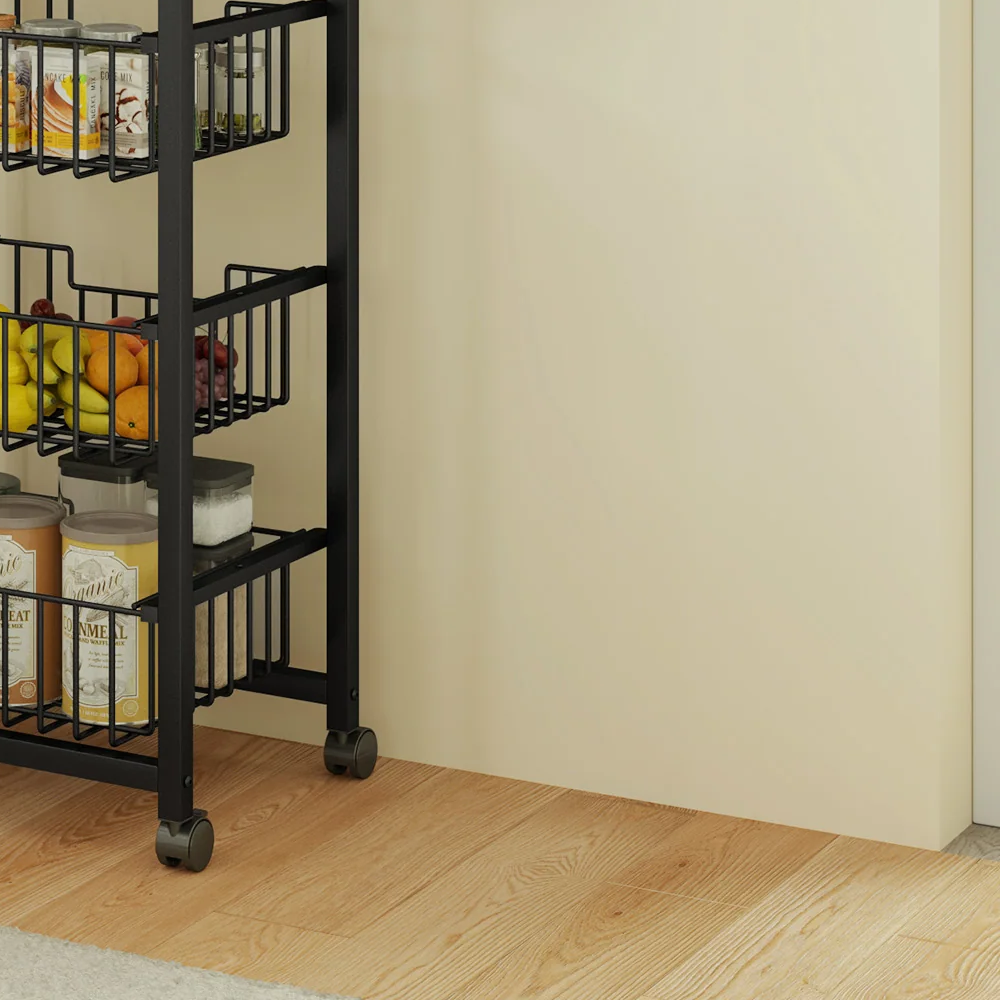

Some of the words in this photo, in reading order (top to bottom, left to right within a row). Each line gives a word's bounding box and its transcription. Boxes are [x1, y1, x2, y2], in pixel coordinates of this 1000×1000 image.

[45, 72, 66, 83] NCAKE
[120, 72, 133, 82] MIX
[64, 616, 128, 640] CONMEL
[90, 638, 109, 646] WAFFL
